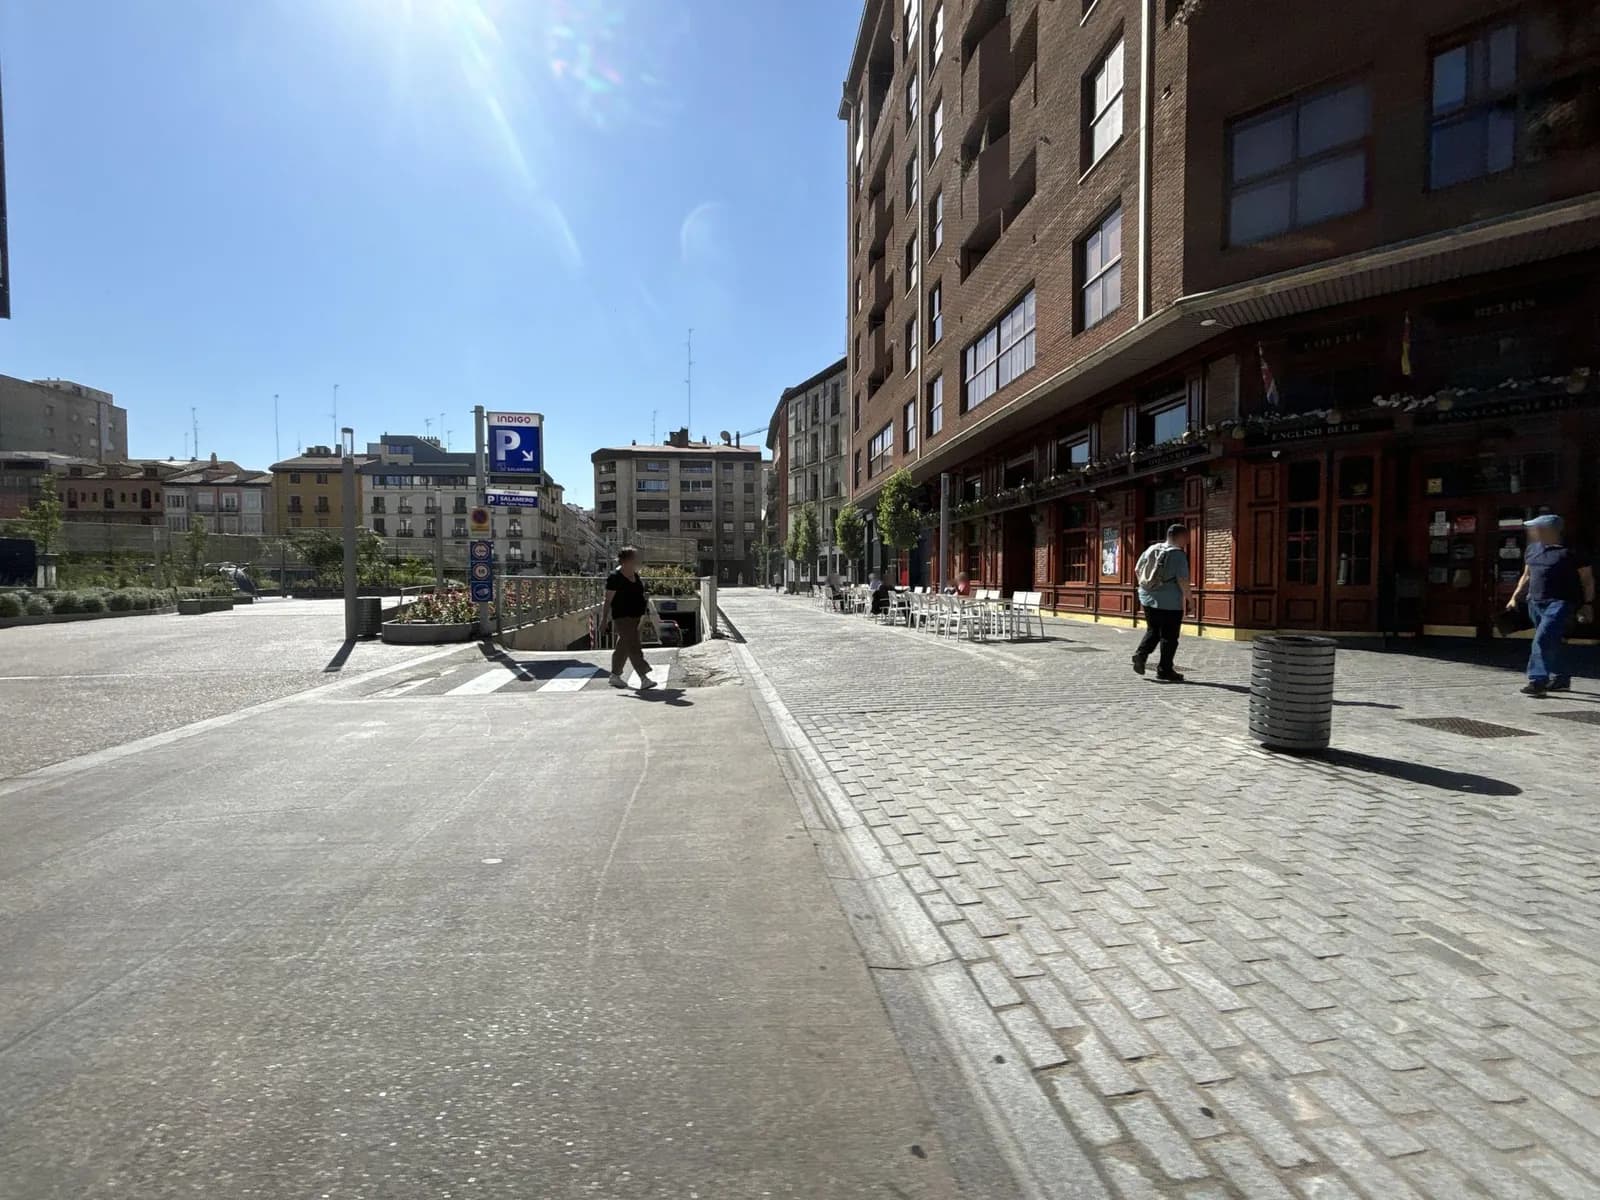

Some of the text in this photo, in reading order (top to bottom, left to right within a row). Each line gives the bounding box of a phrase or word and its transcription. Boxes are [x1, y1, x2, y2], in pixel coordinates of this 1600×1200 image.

[497, 415, 531, 424] INDIGO
[1327, 423, 1360, 434] BEER
[495, 429, 521, 461] P
[487, 495, 495, 504] P
